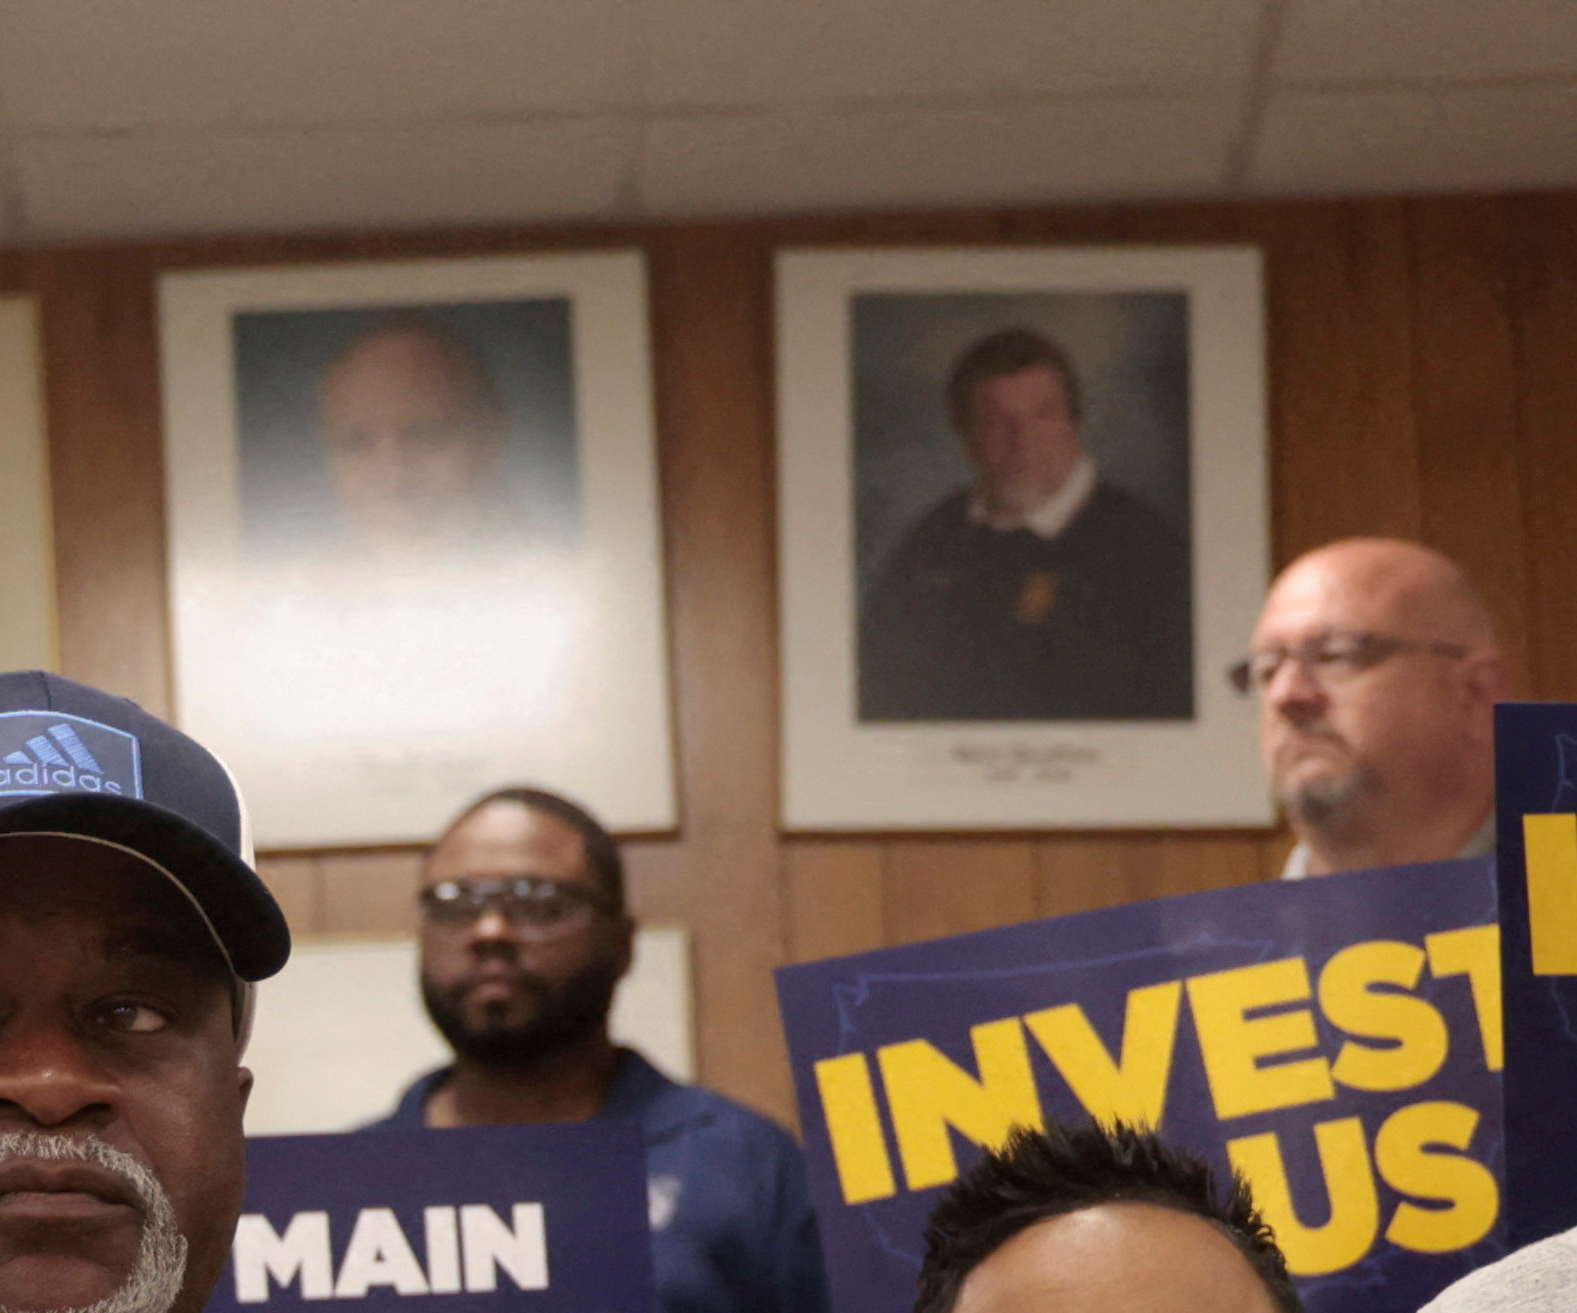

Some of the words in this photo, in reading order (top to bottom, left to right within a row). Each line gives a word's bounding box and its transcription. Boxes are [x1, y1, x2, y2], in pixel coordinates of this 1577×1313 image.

[814, 924, 1503, 1205] INVEST
[231, 1202, 550, 1304] MAIN
[1225, 1100, 1501, 1276] US
